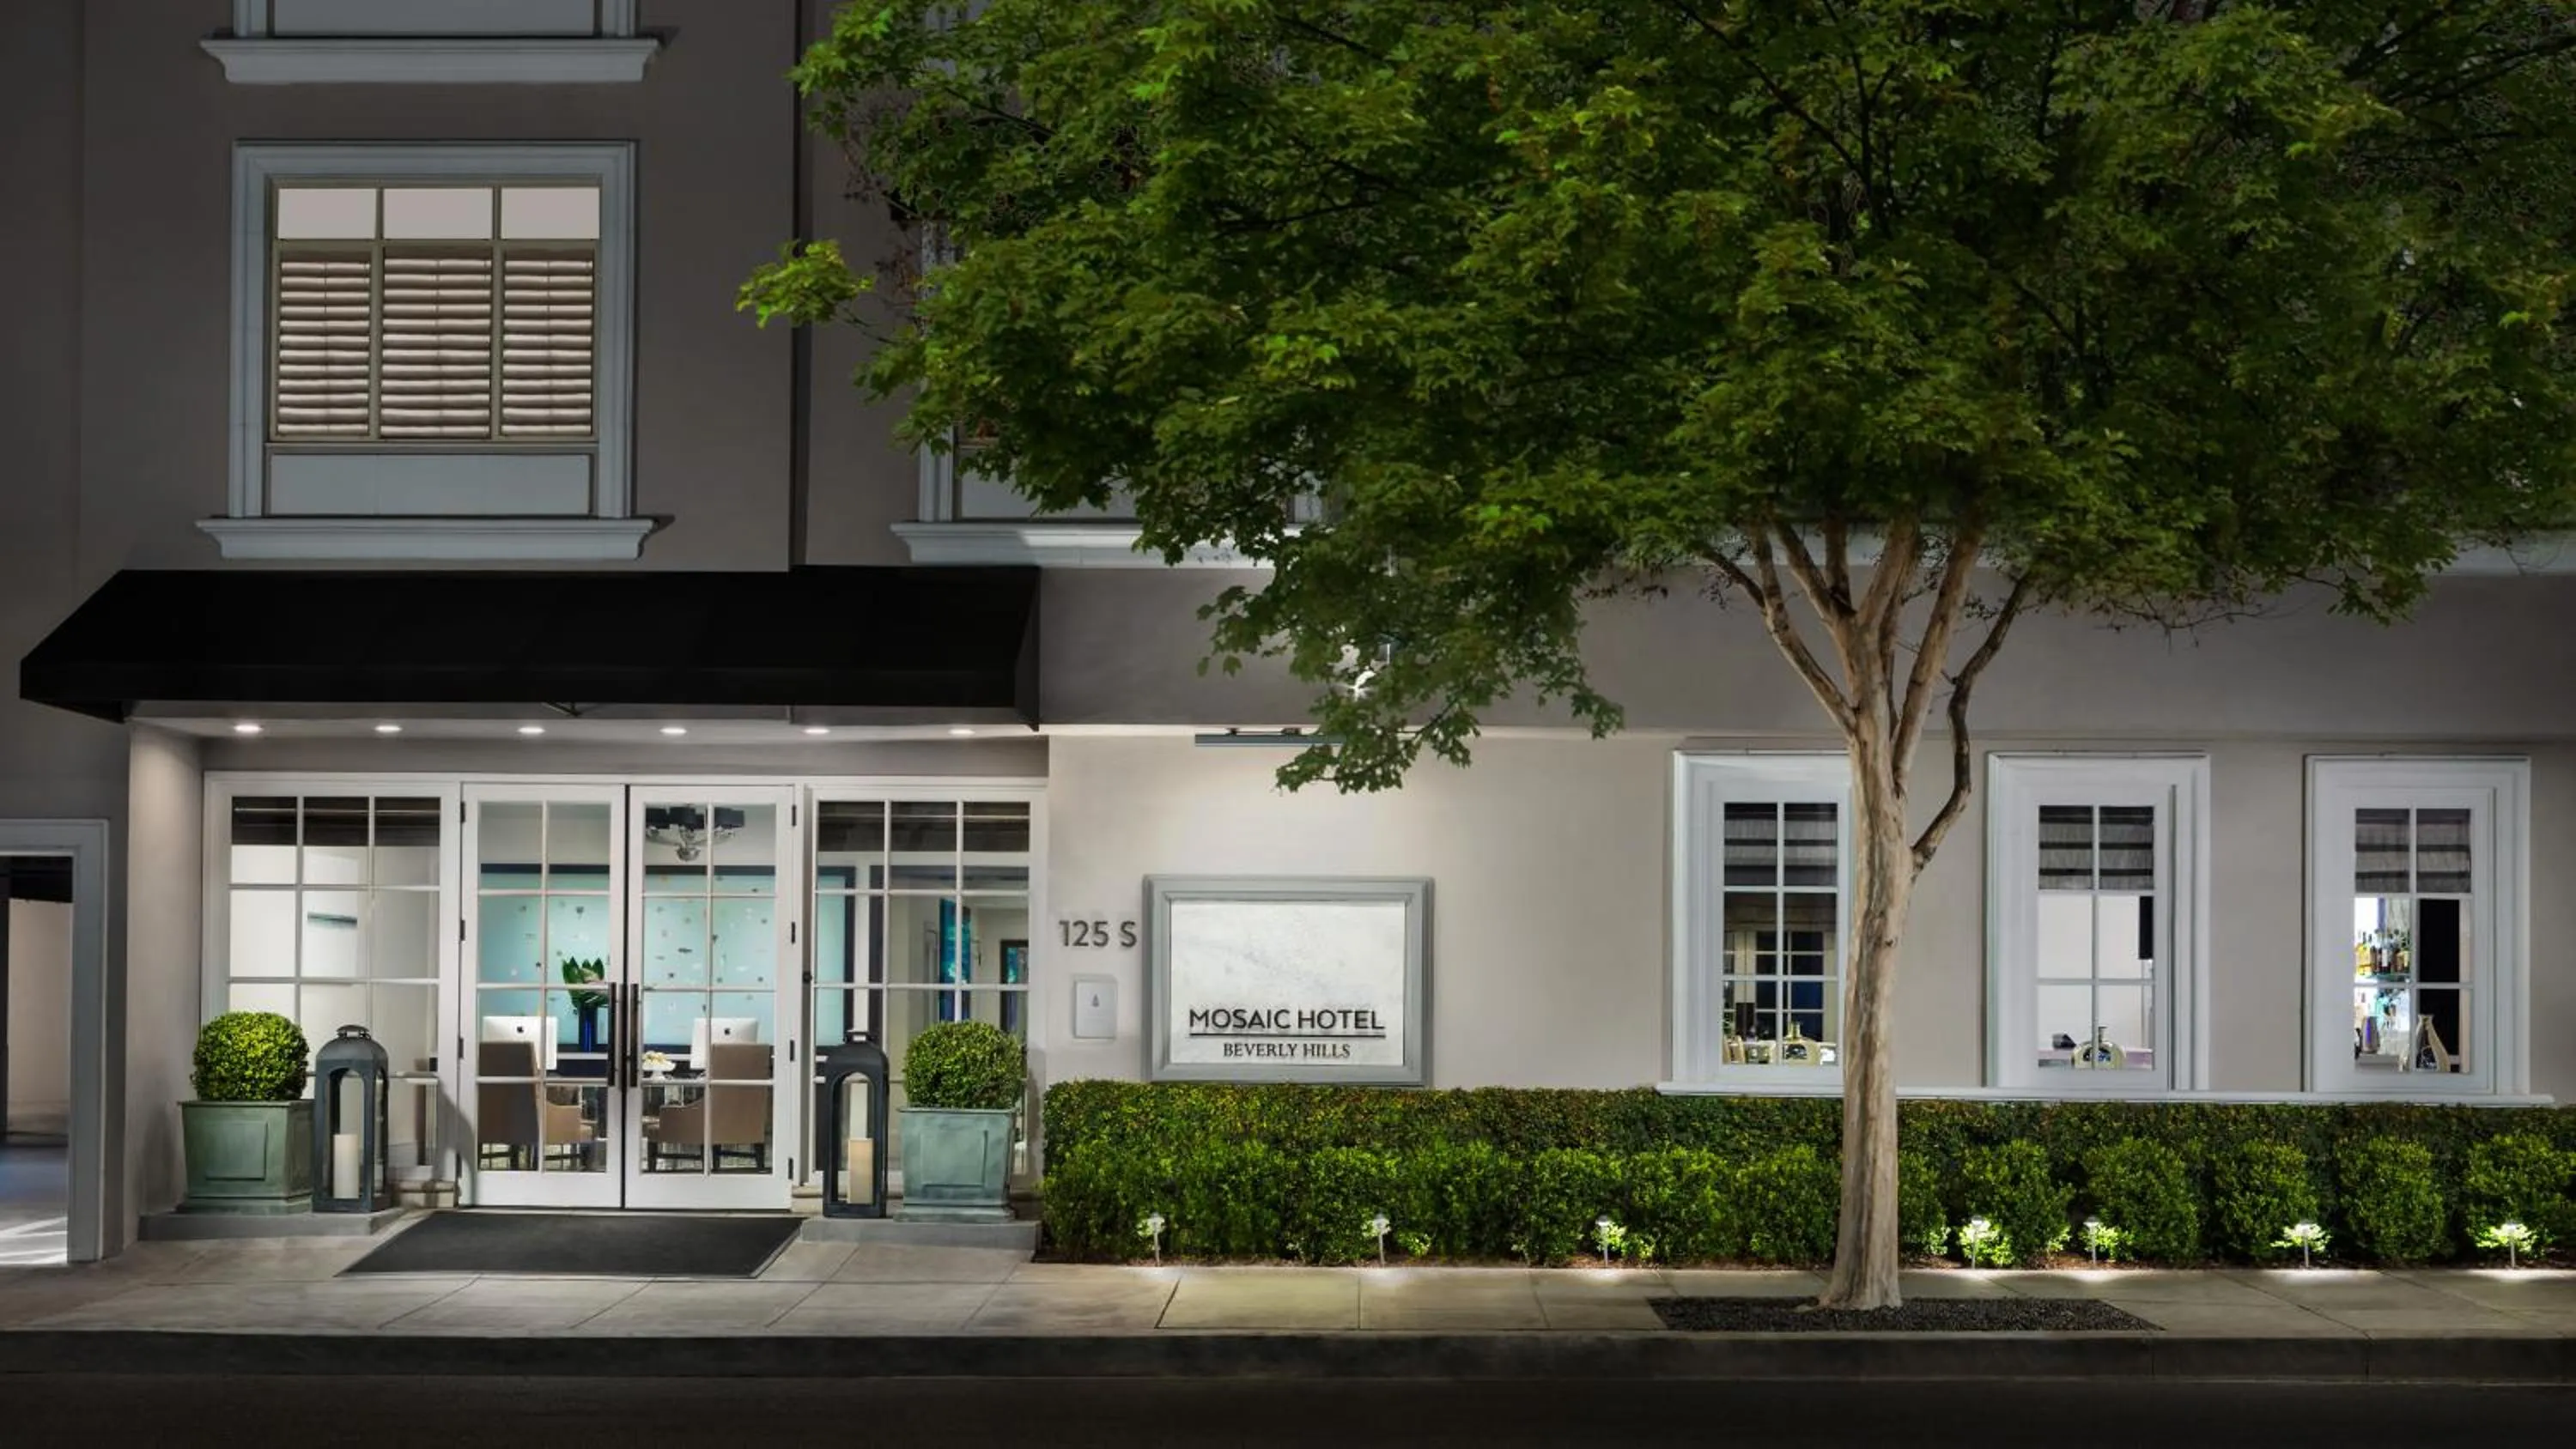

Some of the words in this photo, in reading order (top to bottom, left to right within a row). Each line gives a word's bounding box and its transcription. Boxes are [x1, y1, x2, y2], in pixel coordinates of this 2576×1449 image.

[1059, 920, 1109, 948] 125
[1120, 920, 1138, 948] S
[1189, 1009, 1291, 1029] MOSAIC
[1297, 1009, 1385, 1030] HOTEL
[1224, 1042, 1297, 1058] BEVERLY
[1303, 1043, 1351, 1059] HILLS
